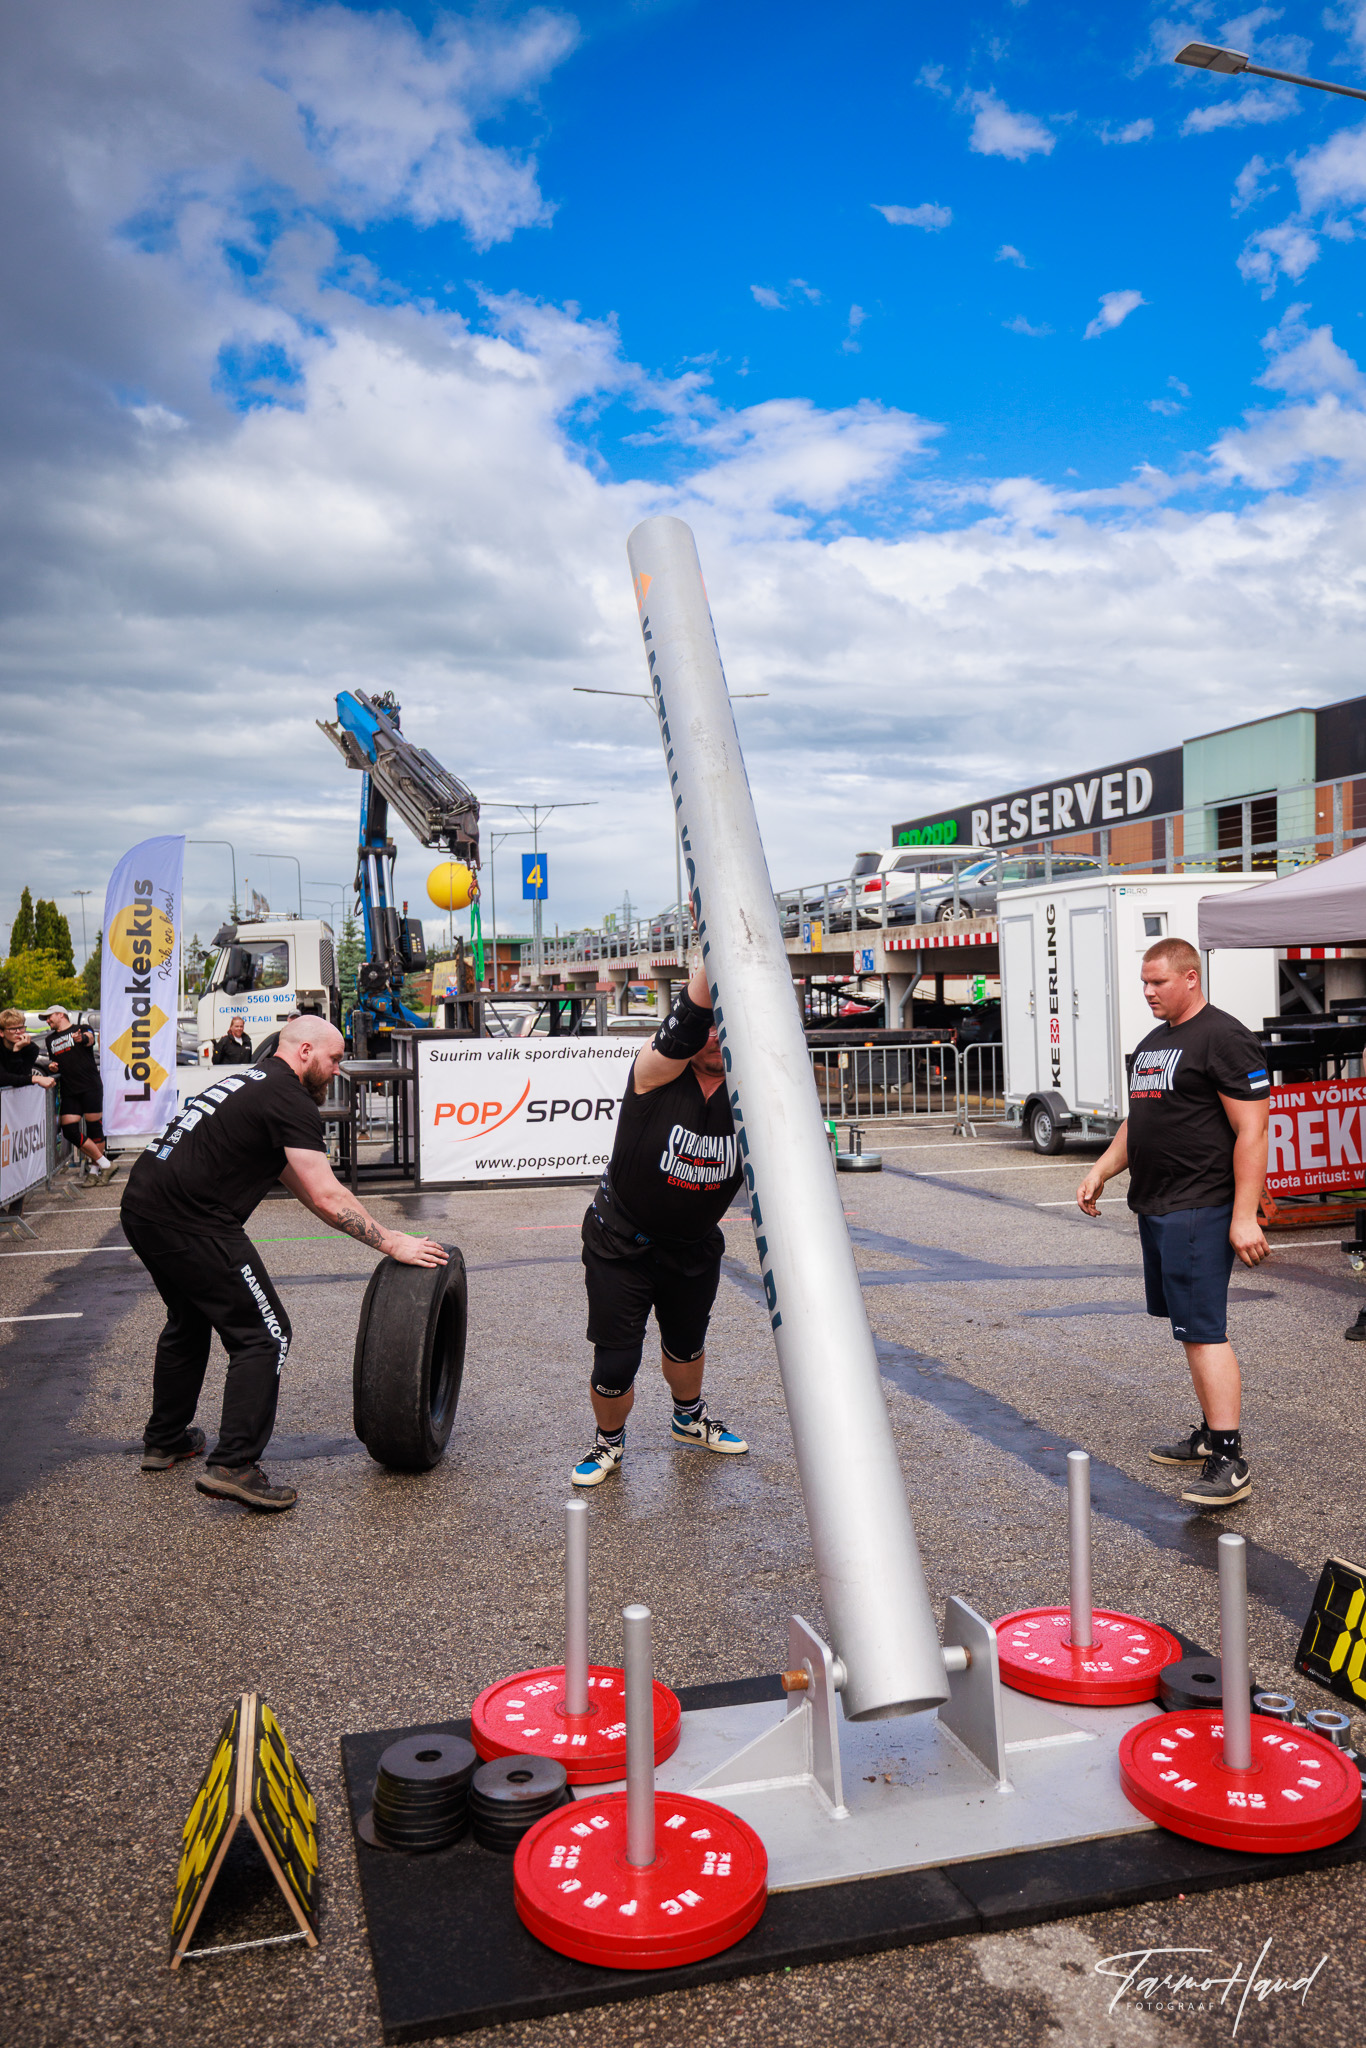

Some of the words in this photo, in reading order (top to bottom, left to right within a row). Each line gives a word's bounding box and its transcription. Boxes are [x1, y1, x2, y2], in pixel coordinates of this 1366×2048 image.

[971, 767, 1153, 846] RESERVED
[526, 864, 543, 888] 4
[163, 927, 175, 947] on
[157, 949, 173, 981] Kõik
[124, 879, 154, 1102] Lõunakeskus
[247, 994, 270, 1004] 5560
[272, 993, 296, 1003] 9057
[429, 1049, 482, 1062] Suurim
[488, 1048, 520, 1060] valik
[433, 1101, 503, 1126] POP
[475, 1153, 610, 1171] www.popsport.ee
[667, 1176, 700, 1191] ESTONIA
[704, 1183, 721, 1191] 2026
[1266, 1175, 1301, 1190] toeta
[1304, 1171, 1351, 1186] üritust:
